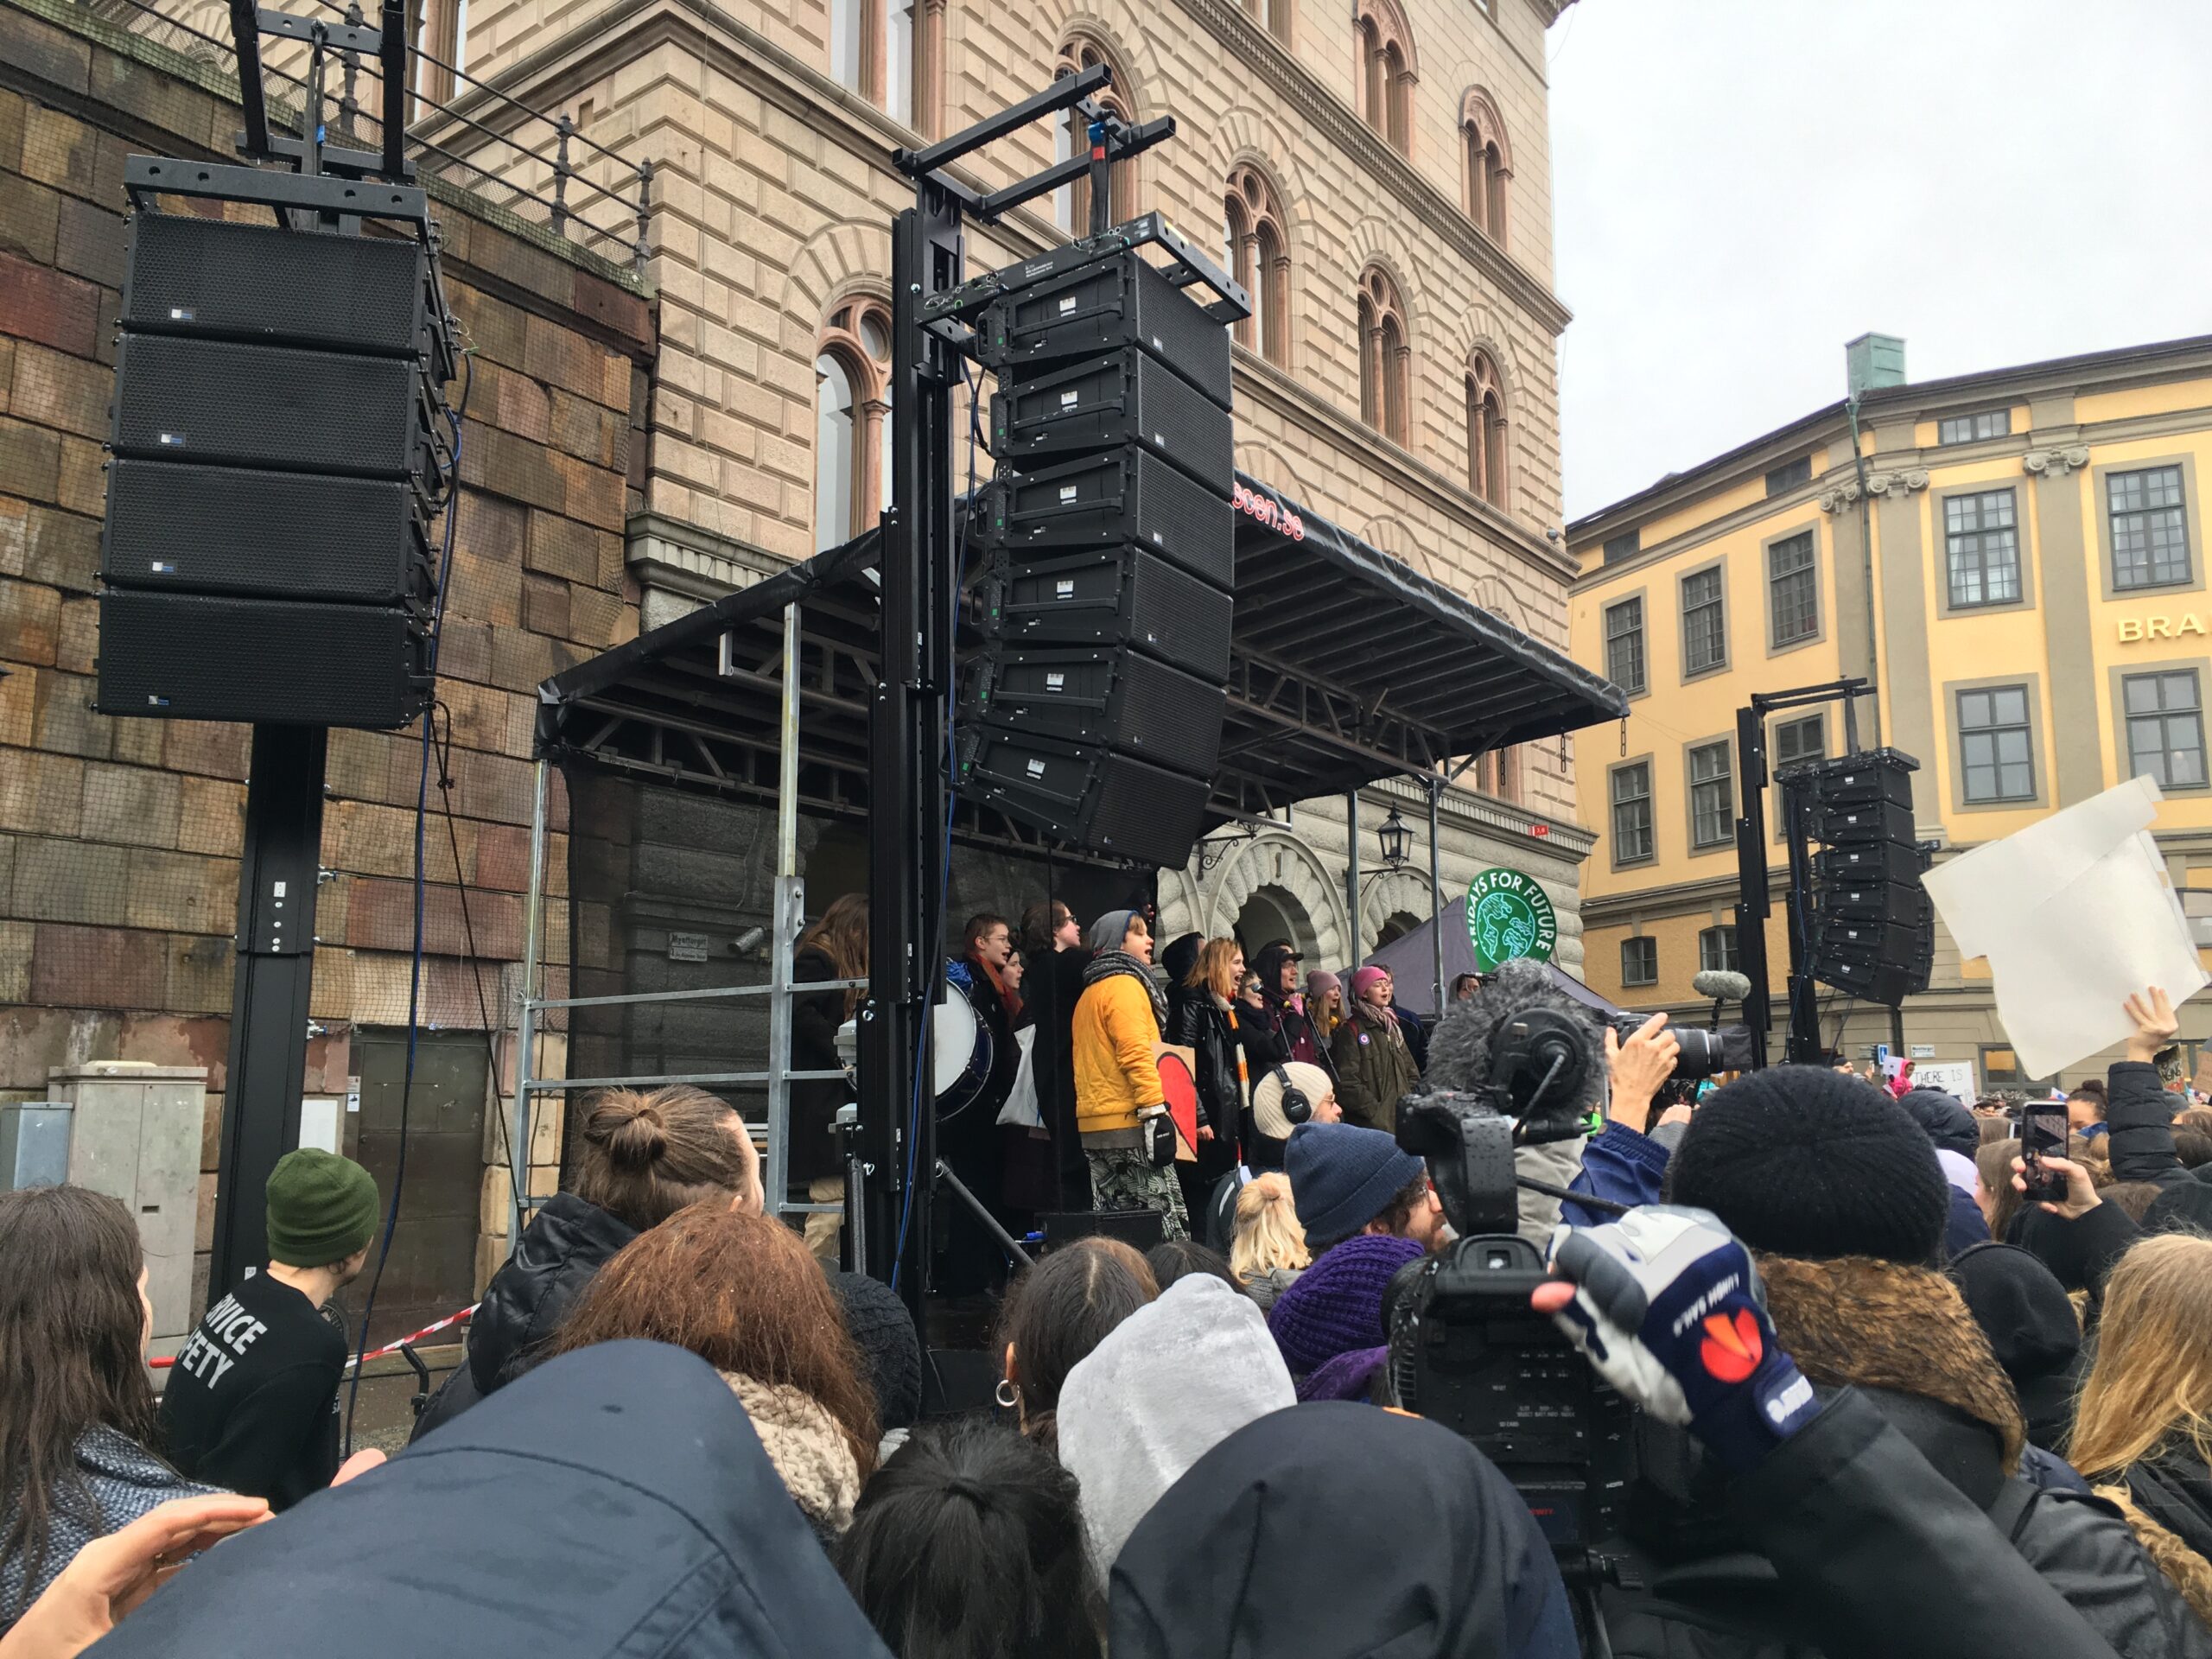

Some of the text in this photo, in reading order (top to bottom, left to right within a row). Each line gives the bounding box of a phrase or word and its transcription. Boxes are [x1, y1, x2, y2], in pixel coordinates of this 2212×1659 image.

[1231, 481, 1305, 542] scen.se
[1467, 872, 1555, 951] FRIDAYS FOR FUTURE
[1914, 1068, 1964, 1084] THERE IS
